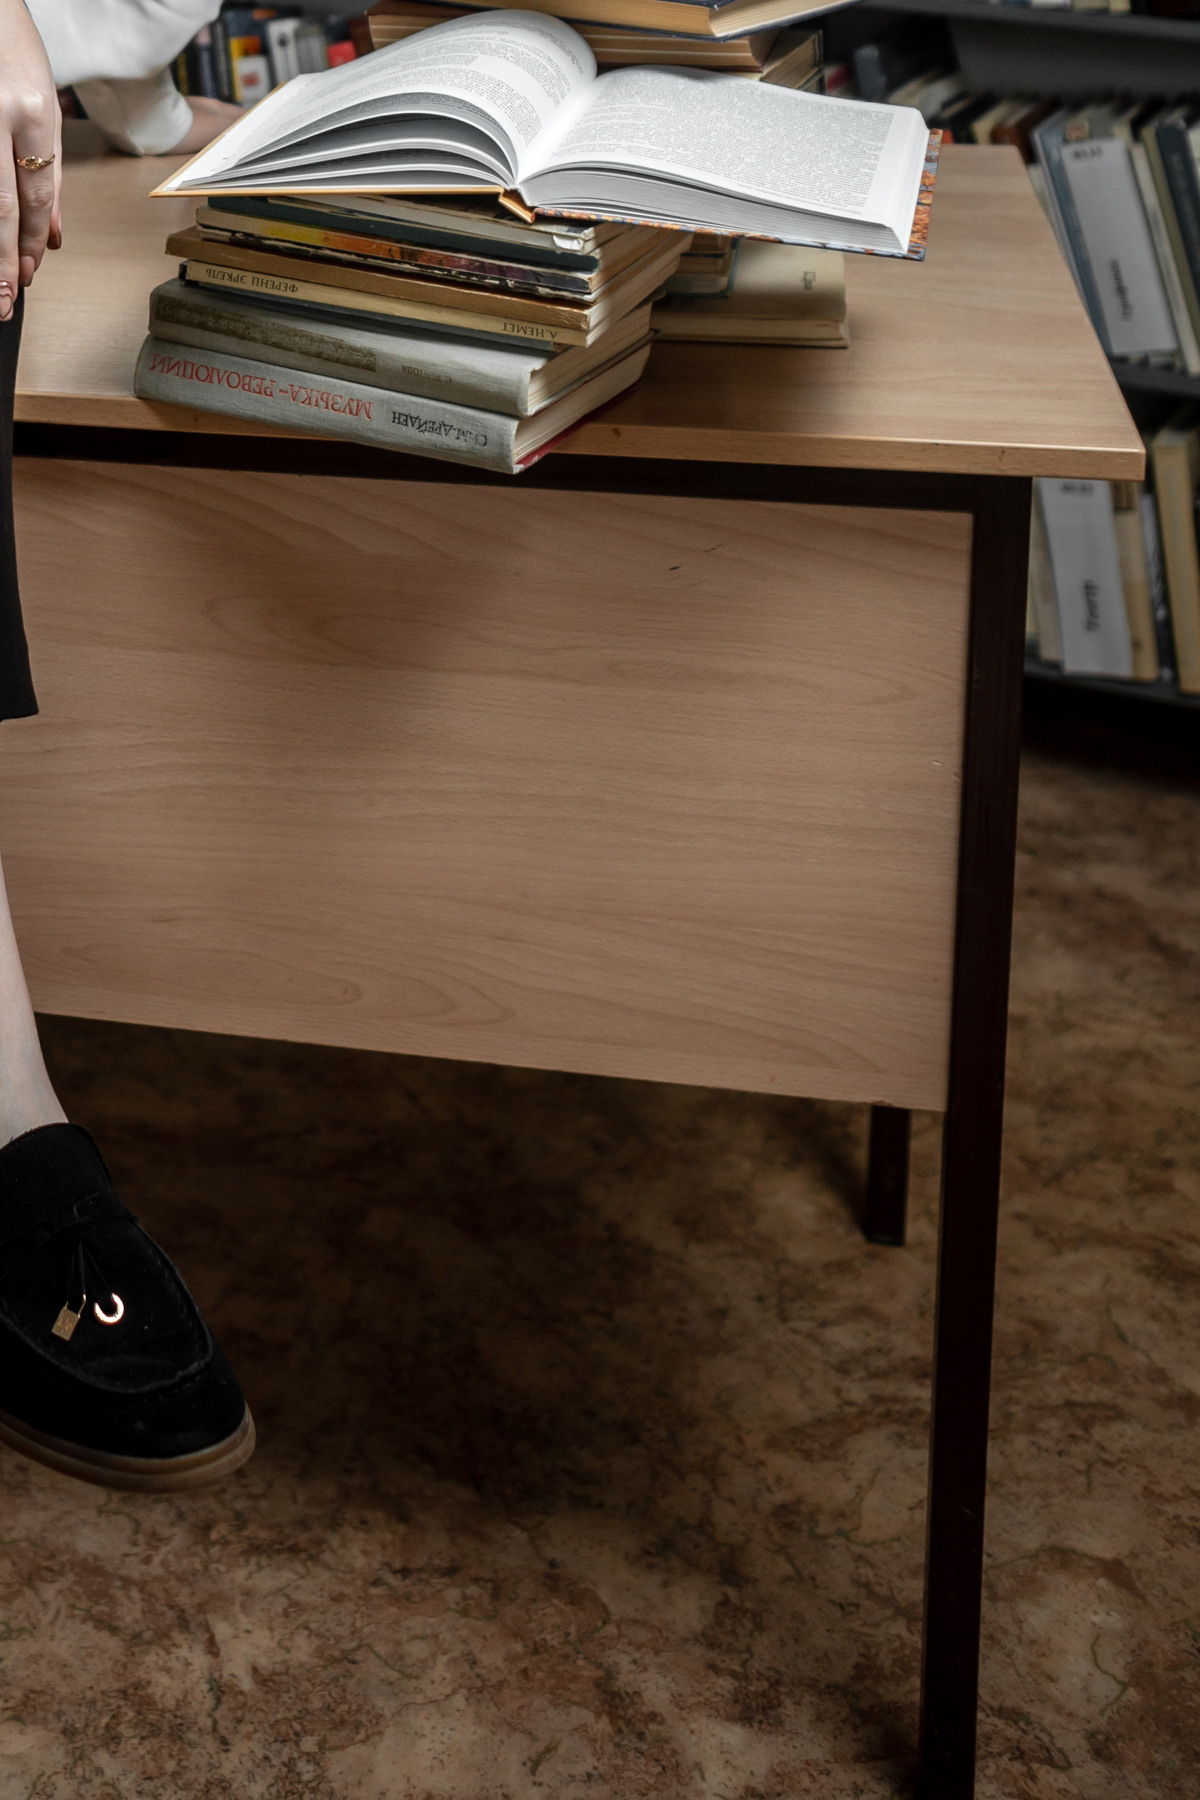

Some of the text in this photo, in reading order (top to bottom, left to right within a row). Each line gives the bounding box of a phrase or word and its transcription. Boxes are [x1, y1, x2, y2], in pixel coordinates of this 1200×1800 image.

[205, 266, 299, 296] ФЕРЕНЦ ЭРКЕЛЬ
[501, 320, 559, 341] А. НЕМЕТ
